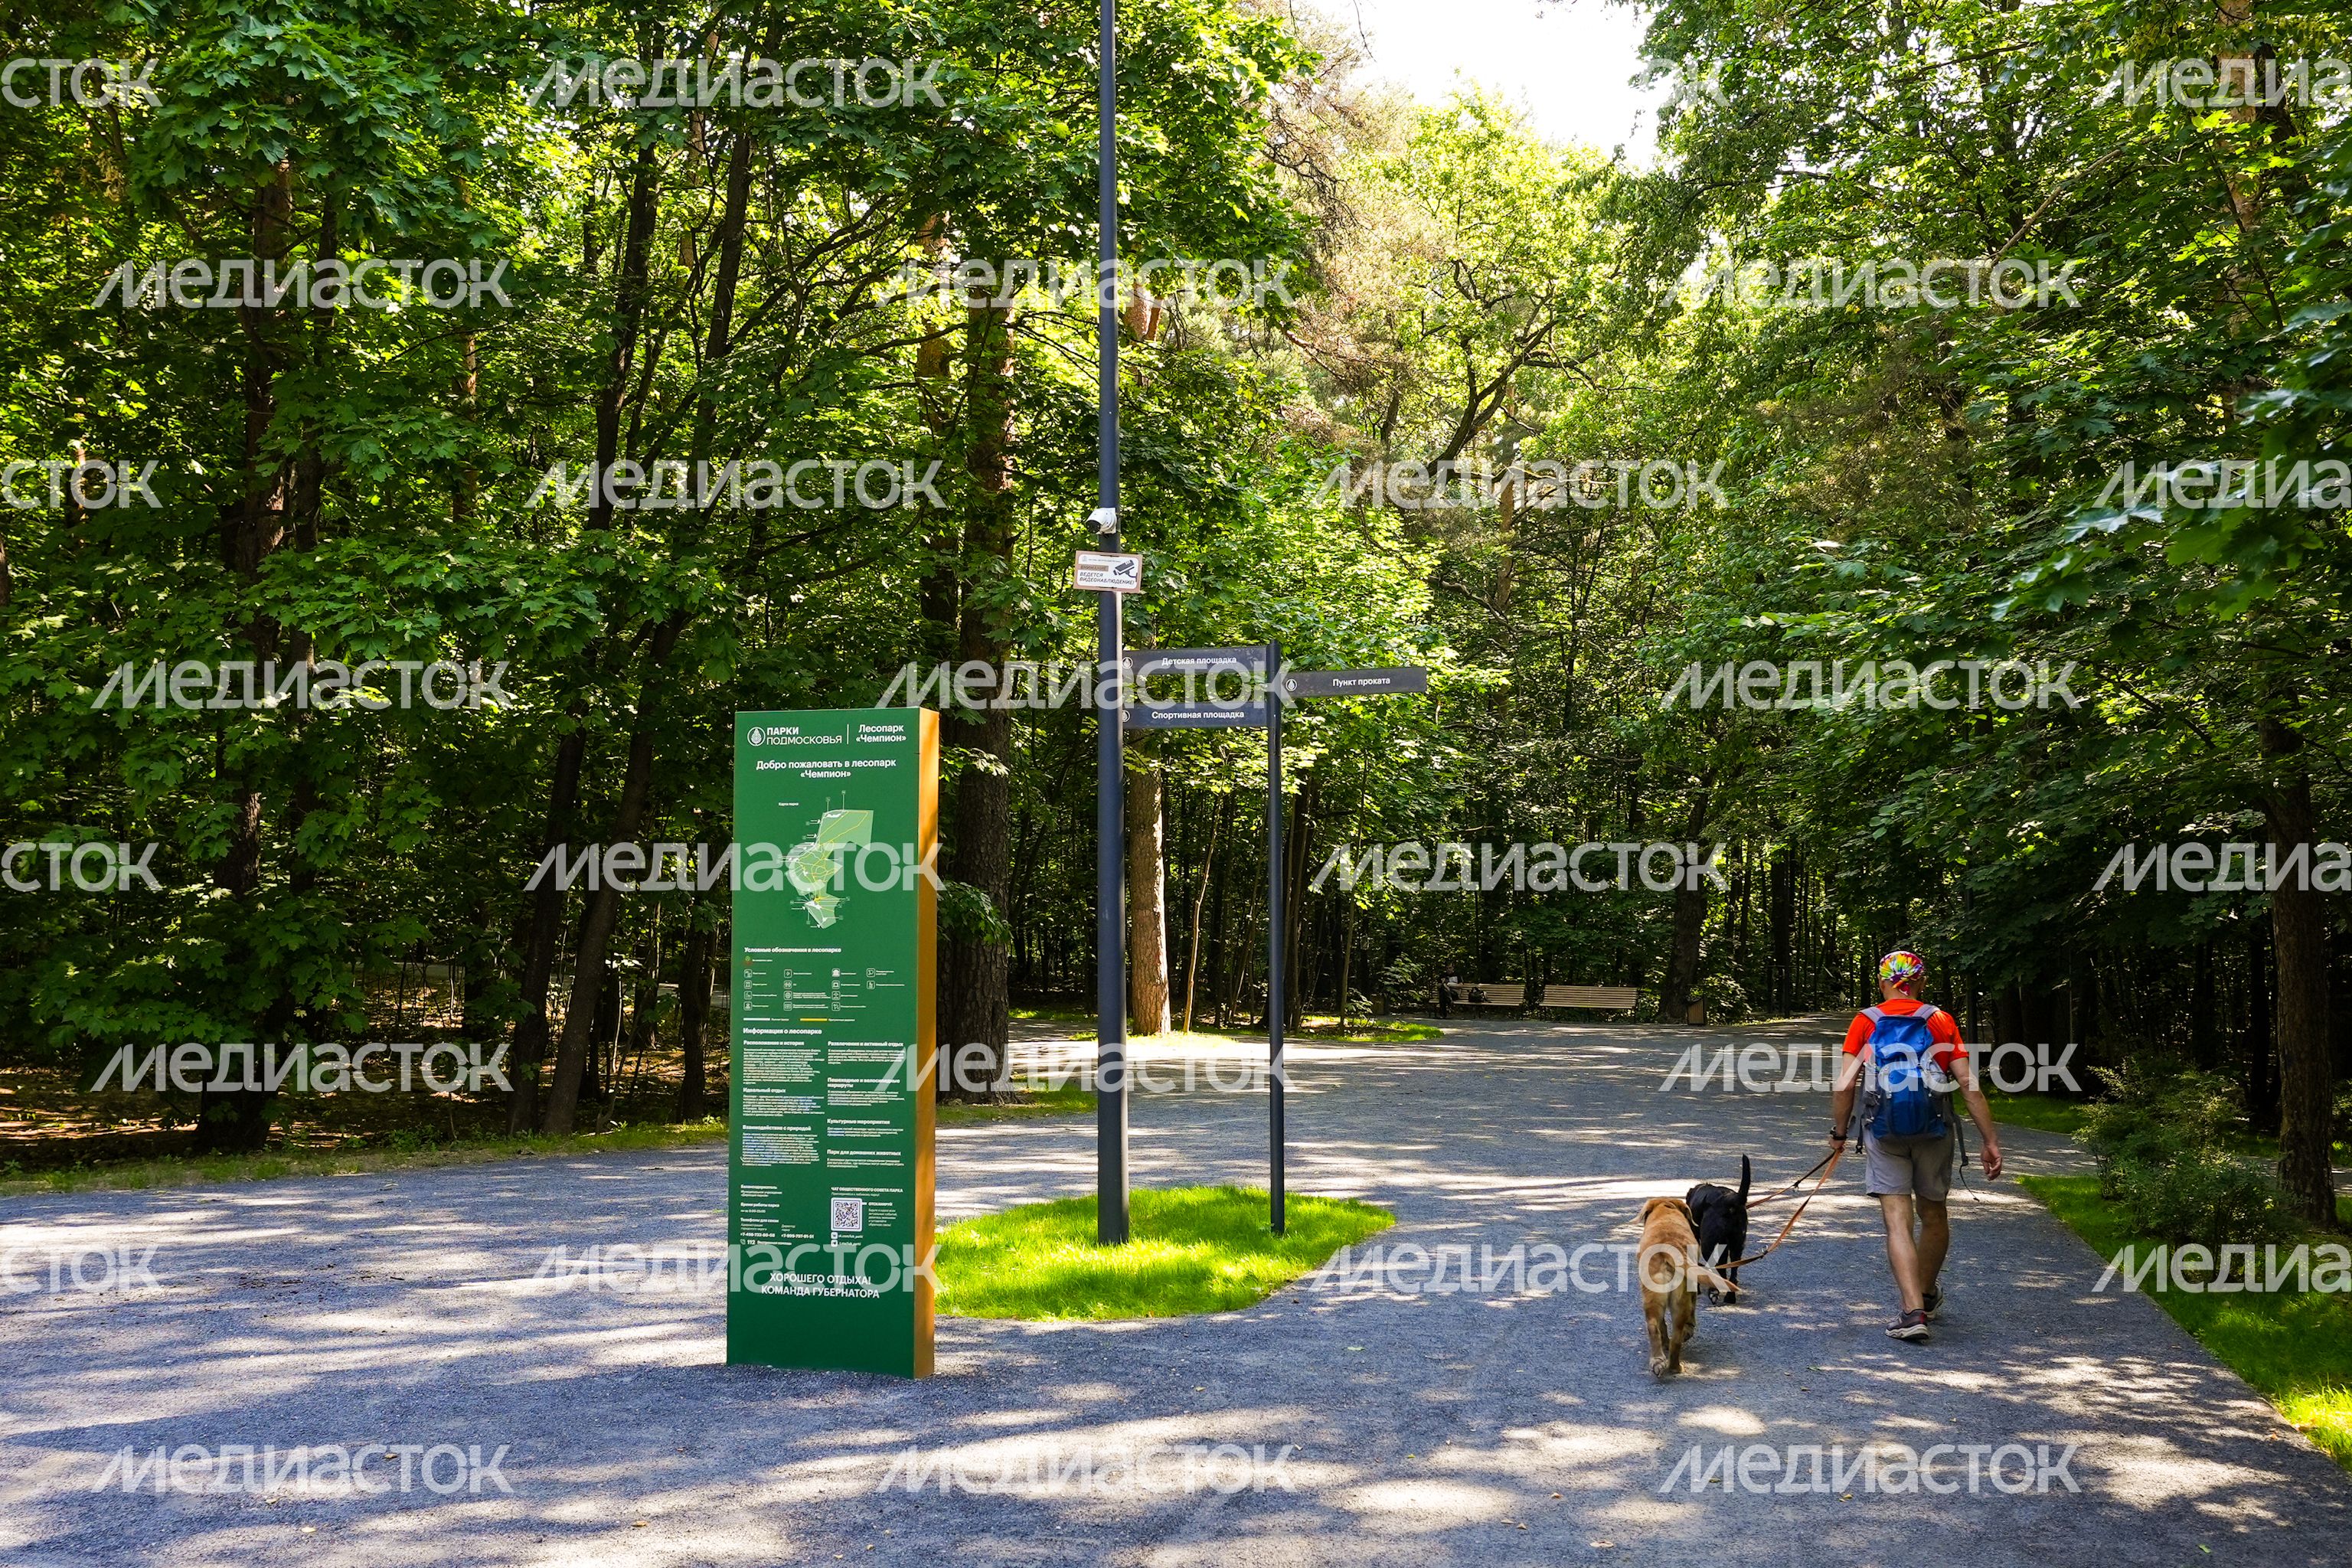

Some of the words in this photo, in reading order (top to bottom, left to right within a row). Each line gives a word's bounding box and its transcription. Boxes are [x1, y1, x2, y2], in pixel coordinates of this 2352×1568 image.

[1161, 657, 1194, 668] Детская
[1196, 656, 1236, 666] площадка
[1333, 678, 1357, 687] Пункт
[1152, 710, 1201, 720] Спортивная
[1203, 710, 1244, 720] площадка
[859, 724, 903, 735] Лесопарк
[767, 734, 842, 745] ПОДМОСКОВЬЯ
[756, 760, 786, 770] Добро
[770, 1272, 825, 1283] ХОРОШЕГО
[827, 1274, 871, 1285] ОТДЫХА!
[762, 1285, 810, 1295] КОМАНДА
[812, 1287, 879, 1298] ГУБЕРНАТОРА
